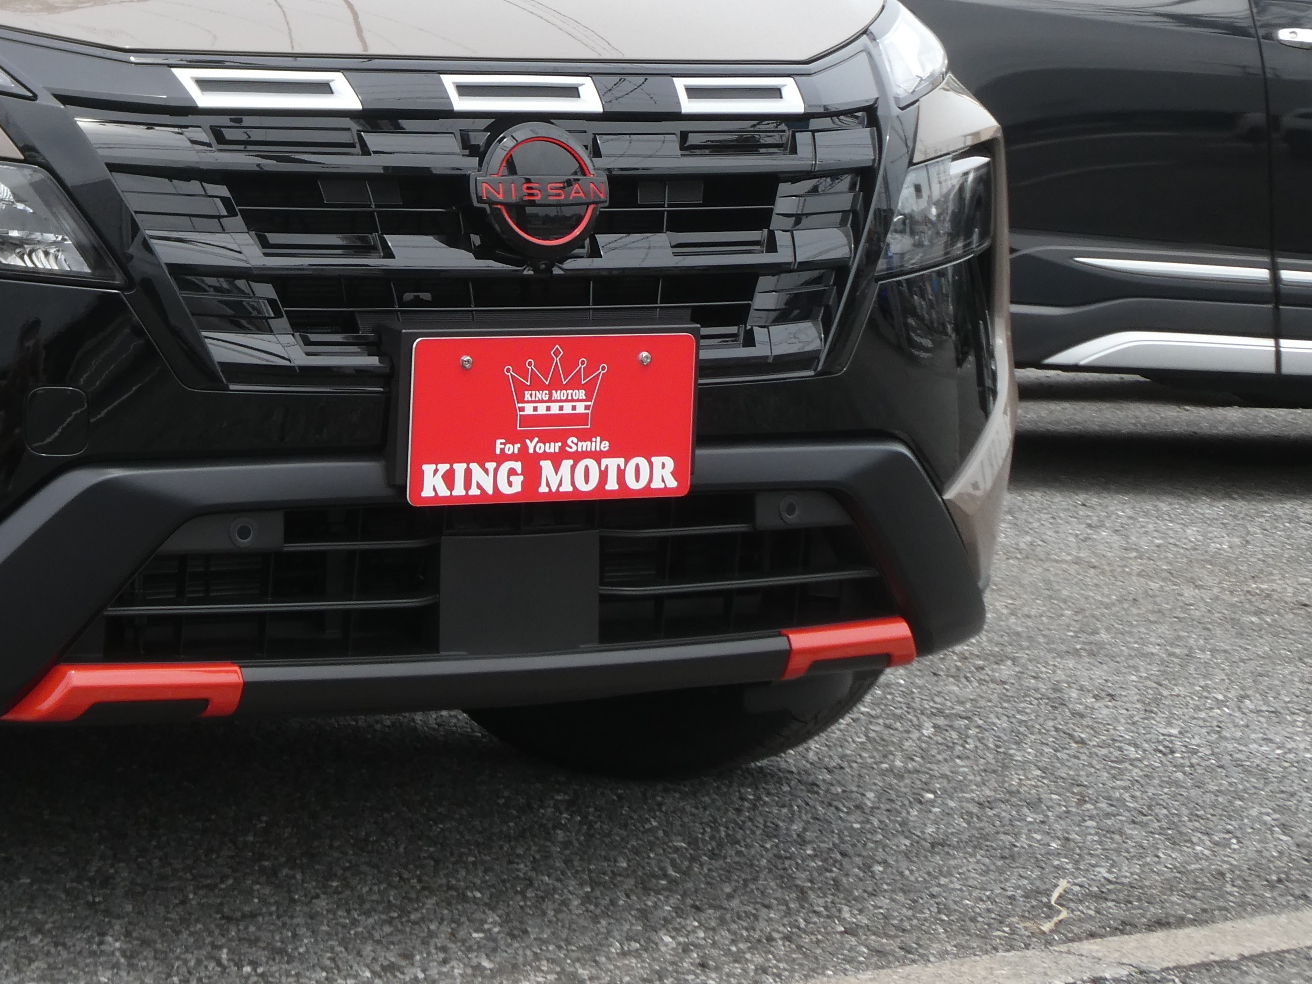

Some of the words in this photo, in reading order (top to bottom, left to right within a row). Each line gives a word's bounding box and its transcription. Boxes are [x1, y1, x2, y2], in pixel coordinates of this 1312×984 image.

[481, 181, 606, 200] NISSAN
[524, 390, 549, 401] KING
[551, 389, 586, 400] MOTOR
[495, 439, 520, 454] For
[525, 437, 562, 453] Your
[565, 436, 610, 452] Smile
[421, 461, 524, 497] KING
[538, 456, 678, 493] MOTOR
